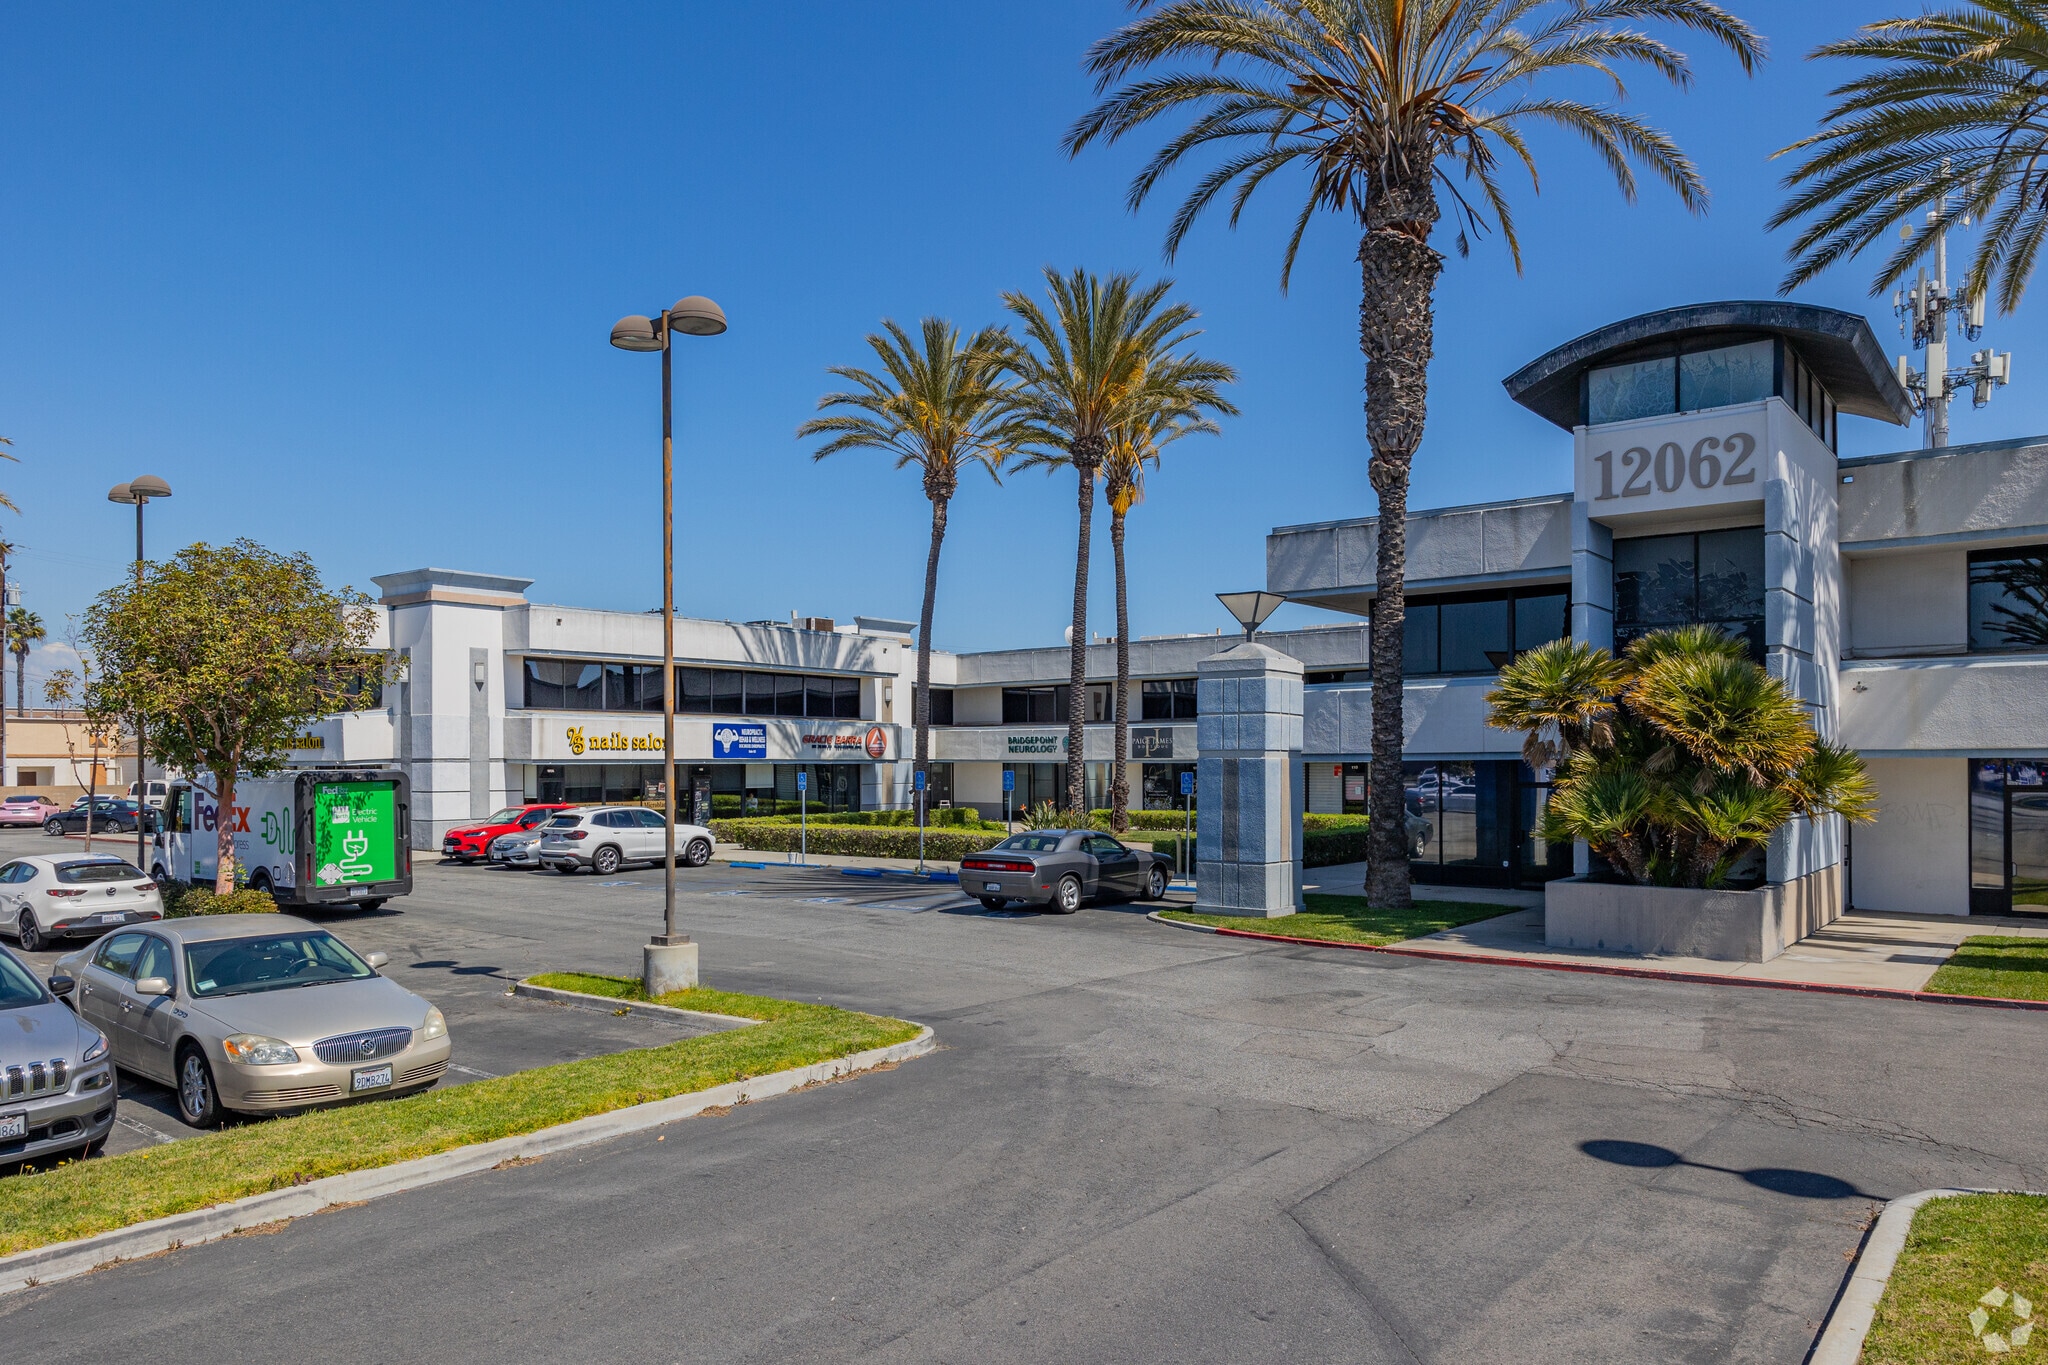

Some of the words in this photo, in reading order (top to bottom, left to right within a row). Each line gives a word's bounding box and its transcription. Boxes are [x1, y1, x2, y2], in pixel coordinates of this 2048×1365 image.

[1594, 433, 1756, 501] 12062
[296, 731, 323, 749] salon
[588, 731, 629, 751] nails
[631, 732, 666, 751] salo
[802, 734, 833, 745] GRACIE
[835, 735, 863, 746] BARRA
[1008, 745, 1058, 753] NEUROLOGY
[352, 807, 377, 816] Electric
[352, 815, 377, 823] Vehicle
[0, 1123, 22, 1137] 861
